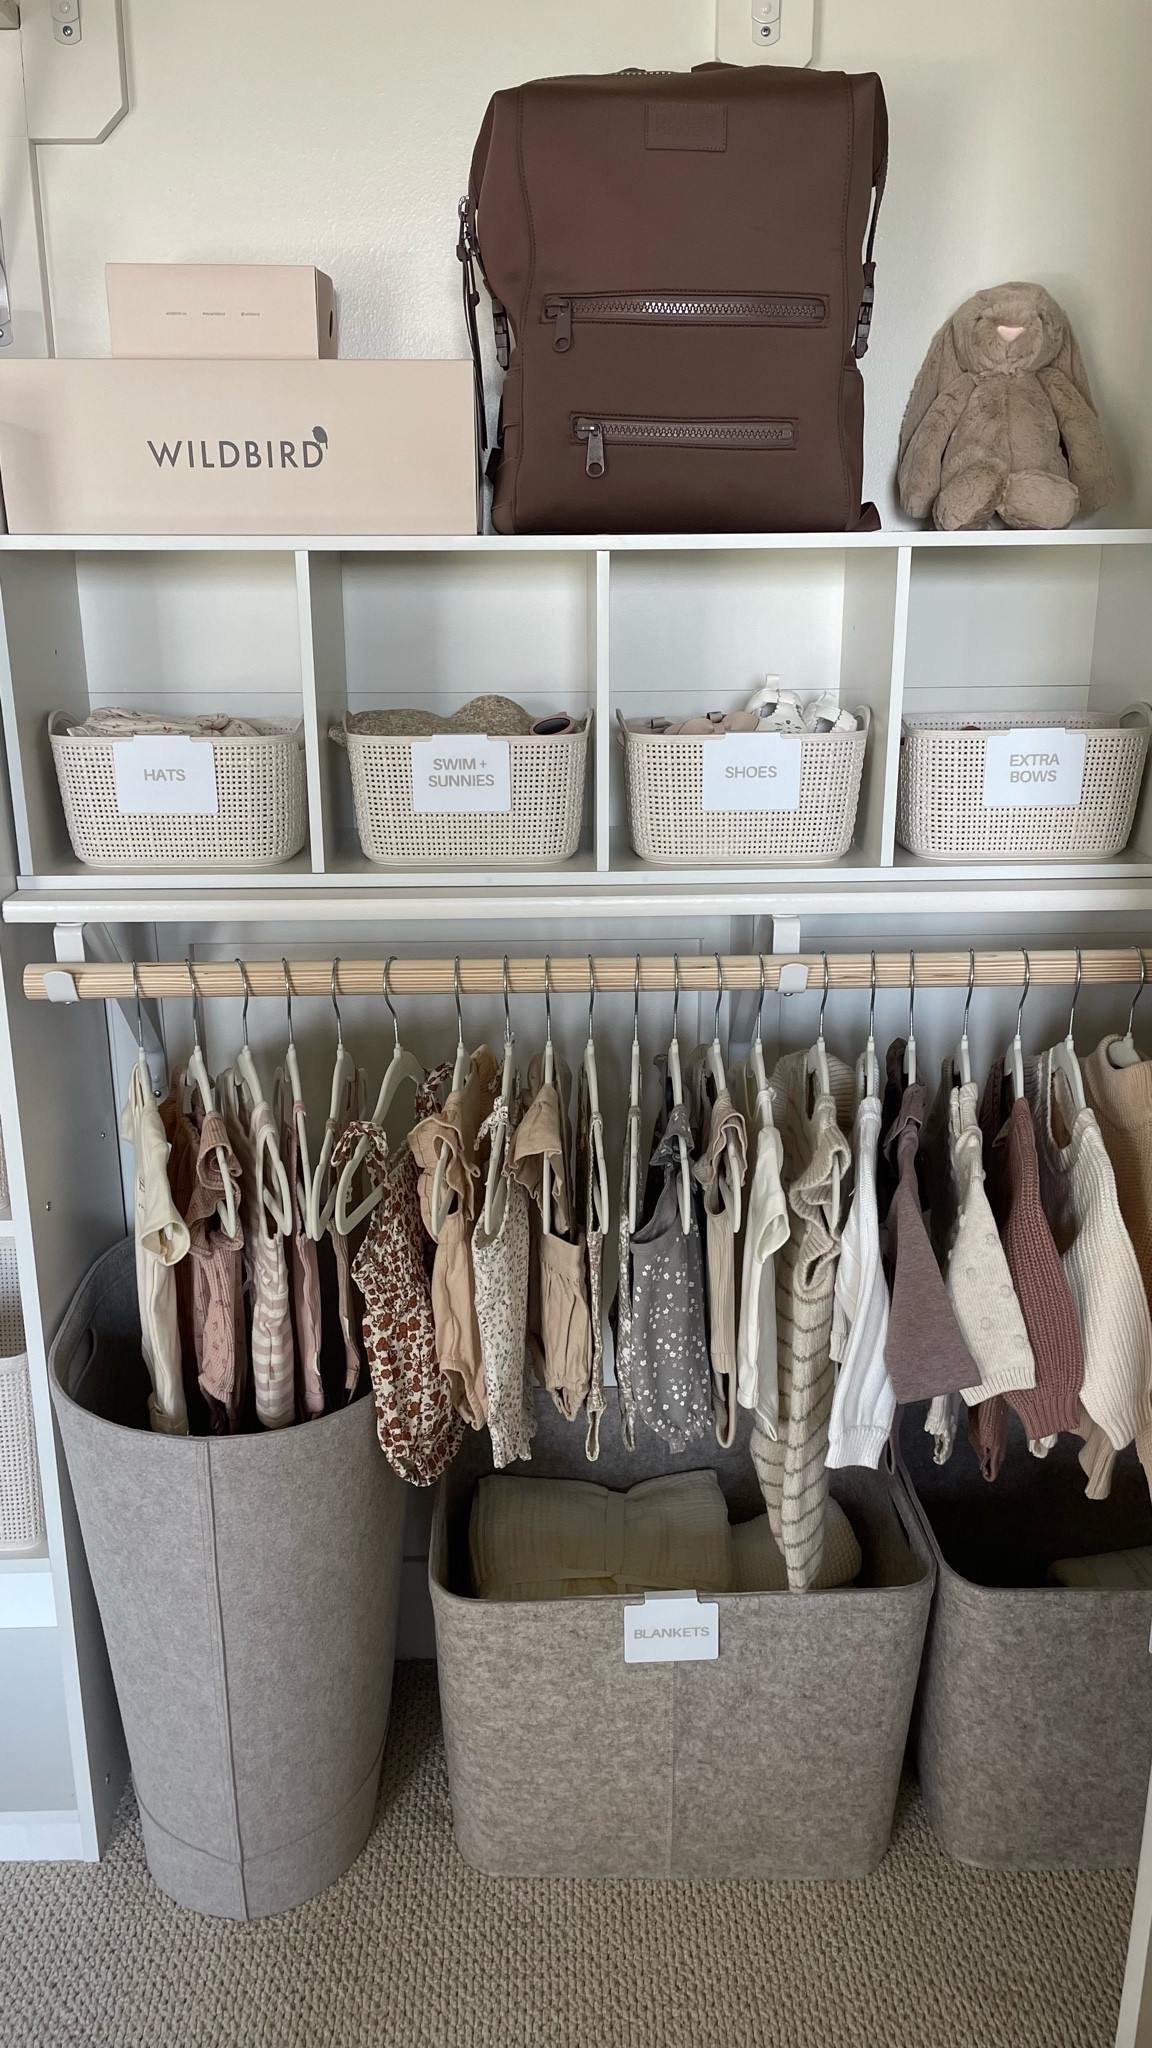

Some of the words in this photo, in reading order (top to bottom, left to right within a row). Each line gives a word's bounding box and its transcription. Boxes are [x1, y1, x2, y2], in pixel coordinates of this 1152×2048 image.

[147, 441, 324, 468] WILDBIRD
[1009, 753, 1060, 767] EXTRA
[144, 768, 186, 782] HATS
[725, 765, 778, 779] SHOES
[1010, 769, 1057, 783] BOWS
[428, 773, 495, 788] SUNNIES
[633, 1626, 710, 1640] BLANKETS
